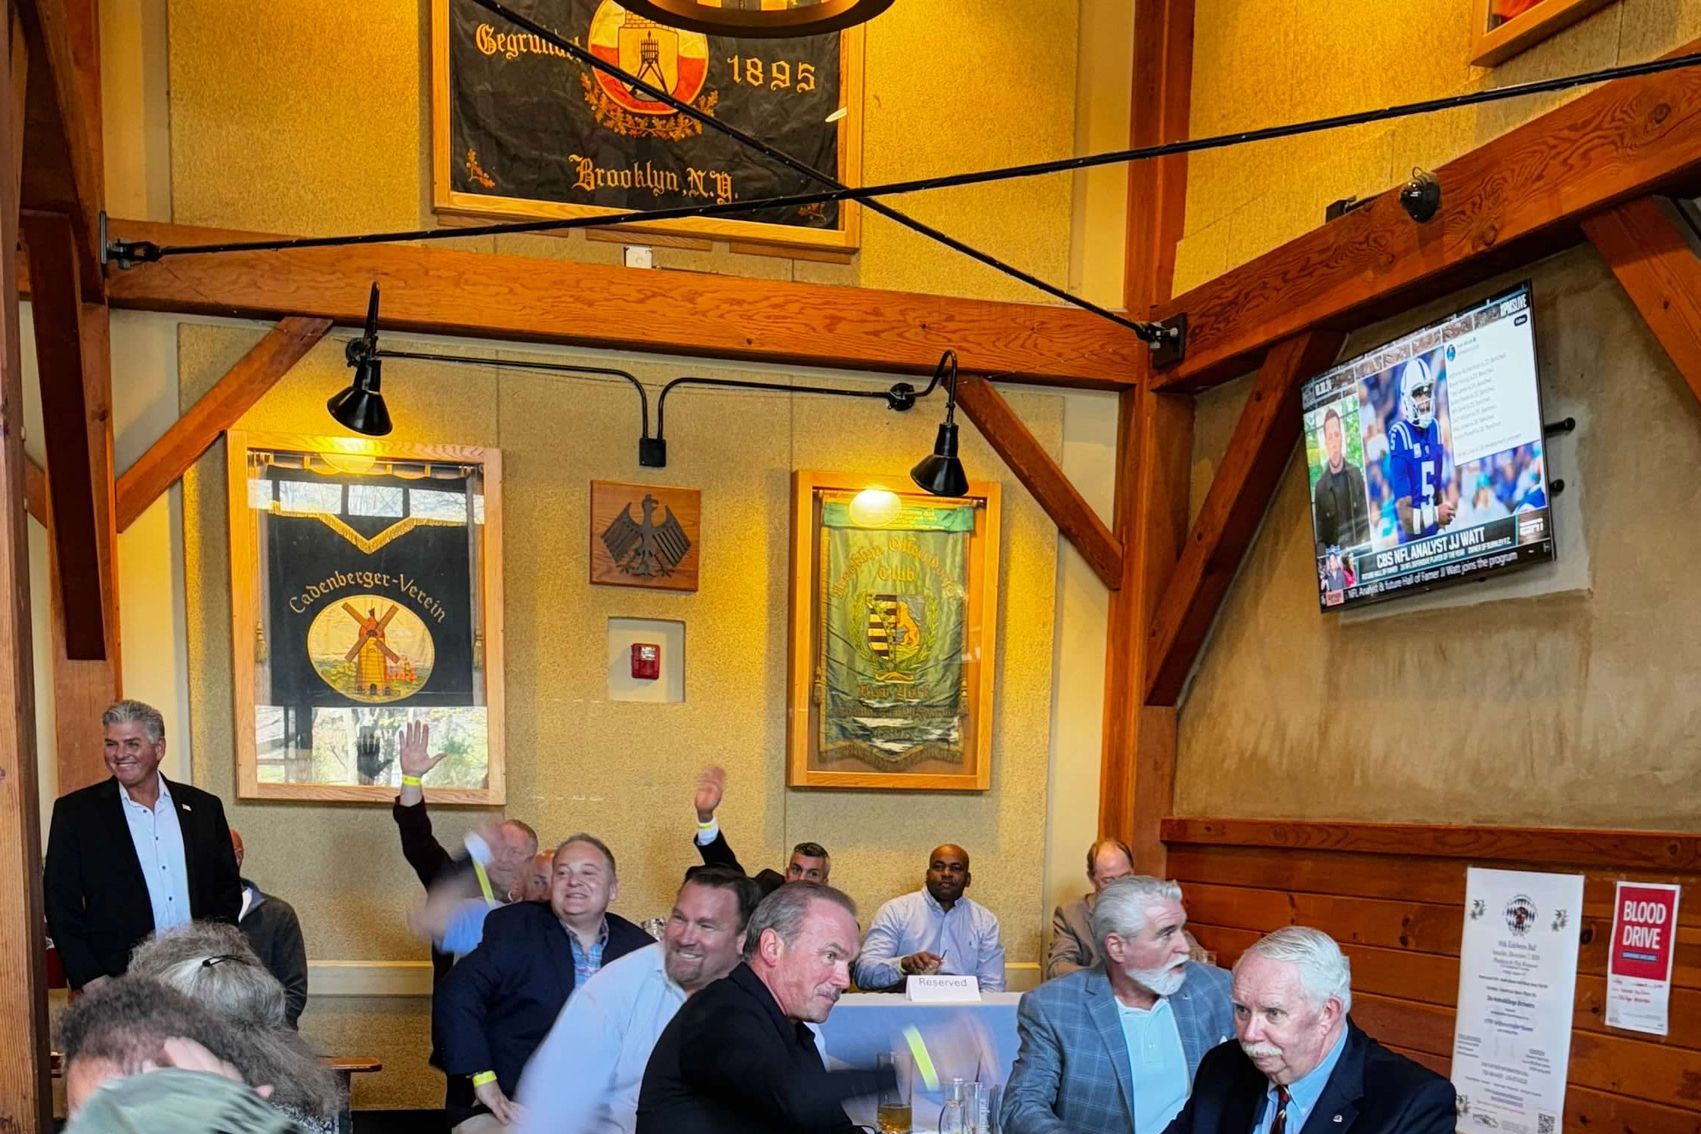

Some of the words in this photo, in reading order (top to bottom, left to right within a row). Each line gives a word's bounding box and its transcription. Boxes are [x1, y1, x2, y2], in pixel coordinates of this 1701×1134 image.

[727, 55, 816, 93] 1895
[1519, 518, 1544, 536] ESPN
[1377, 552, 1394, 568] CBS
[1394, 547, 1411, 564] NFL
[1411, 536, 1449, 560] ANALYST
[1449, 532, 1460, 549] JJ
[1460, 527, 1485, 547] WATT
[878, 565, 916, 582] Club
[1402, 576, 1414, 586] Hall
[1461, 560, 1477, 575] joins
[1477, 557, 1489, 569] the
[1489, 551, 1518, 568] program
[289, 570, 446, 624] Cadenberger-Verein
[1623, 900, 1667, 925] BLOOD
[1622, 925, 1661, 949] DRIVE
[919, 977, 967, 987] Reserved
